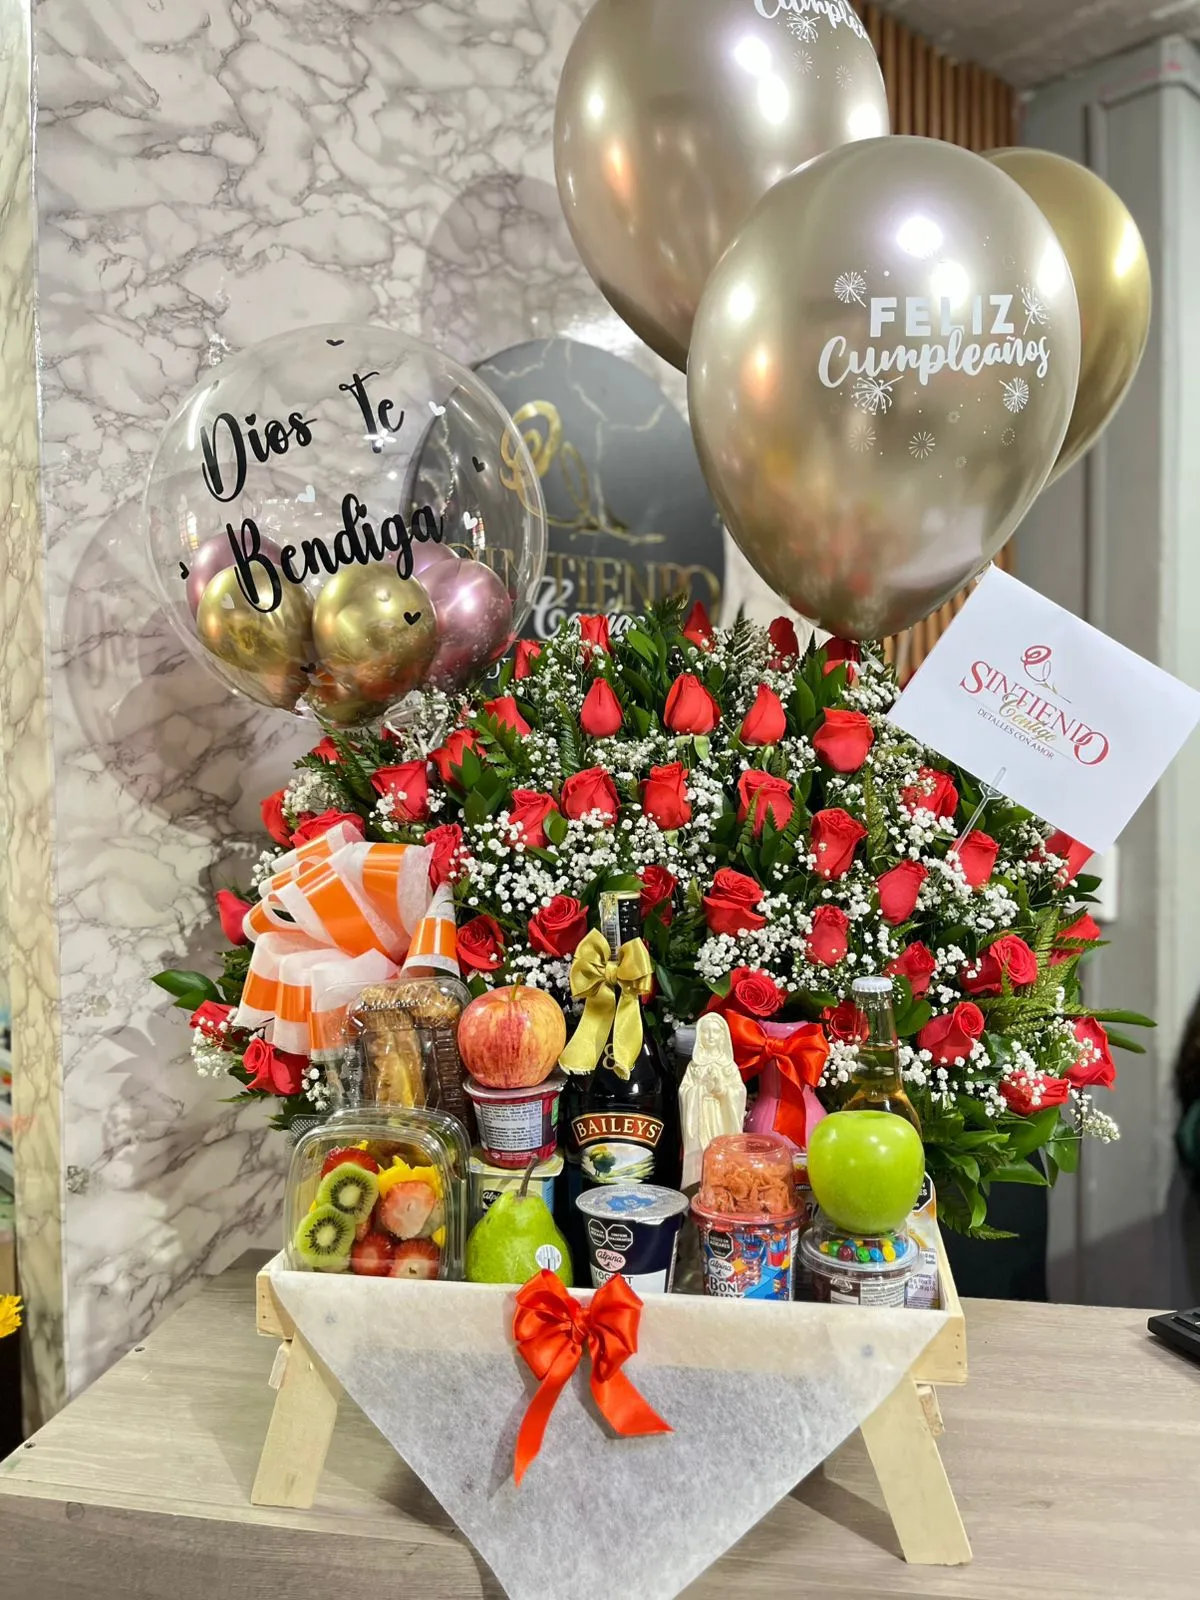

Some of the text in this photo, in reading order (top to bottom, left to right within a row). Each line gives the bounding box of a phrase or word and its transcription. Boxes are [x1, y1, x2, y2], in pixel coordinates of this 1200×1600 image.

[870, 294, 1015, 339] FELIZ
[818, 328, 1051, 389] Cumpleaños
[200, 370, 406, 502] Dios Te
[227, 492, 445, 614] Bendiga
[959, 660, 1110, 766] SINTIENDO
[977, 707, 1055, 760] DETALLES CON AMOR
[998, 693, 1058, 742] Contigo
[575, 1118, 660, 1139] BAILEYS
[594, 1269, 634, 1284] YOGT
